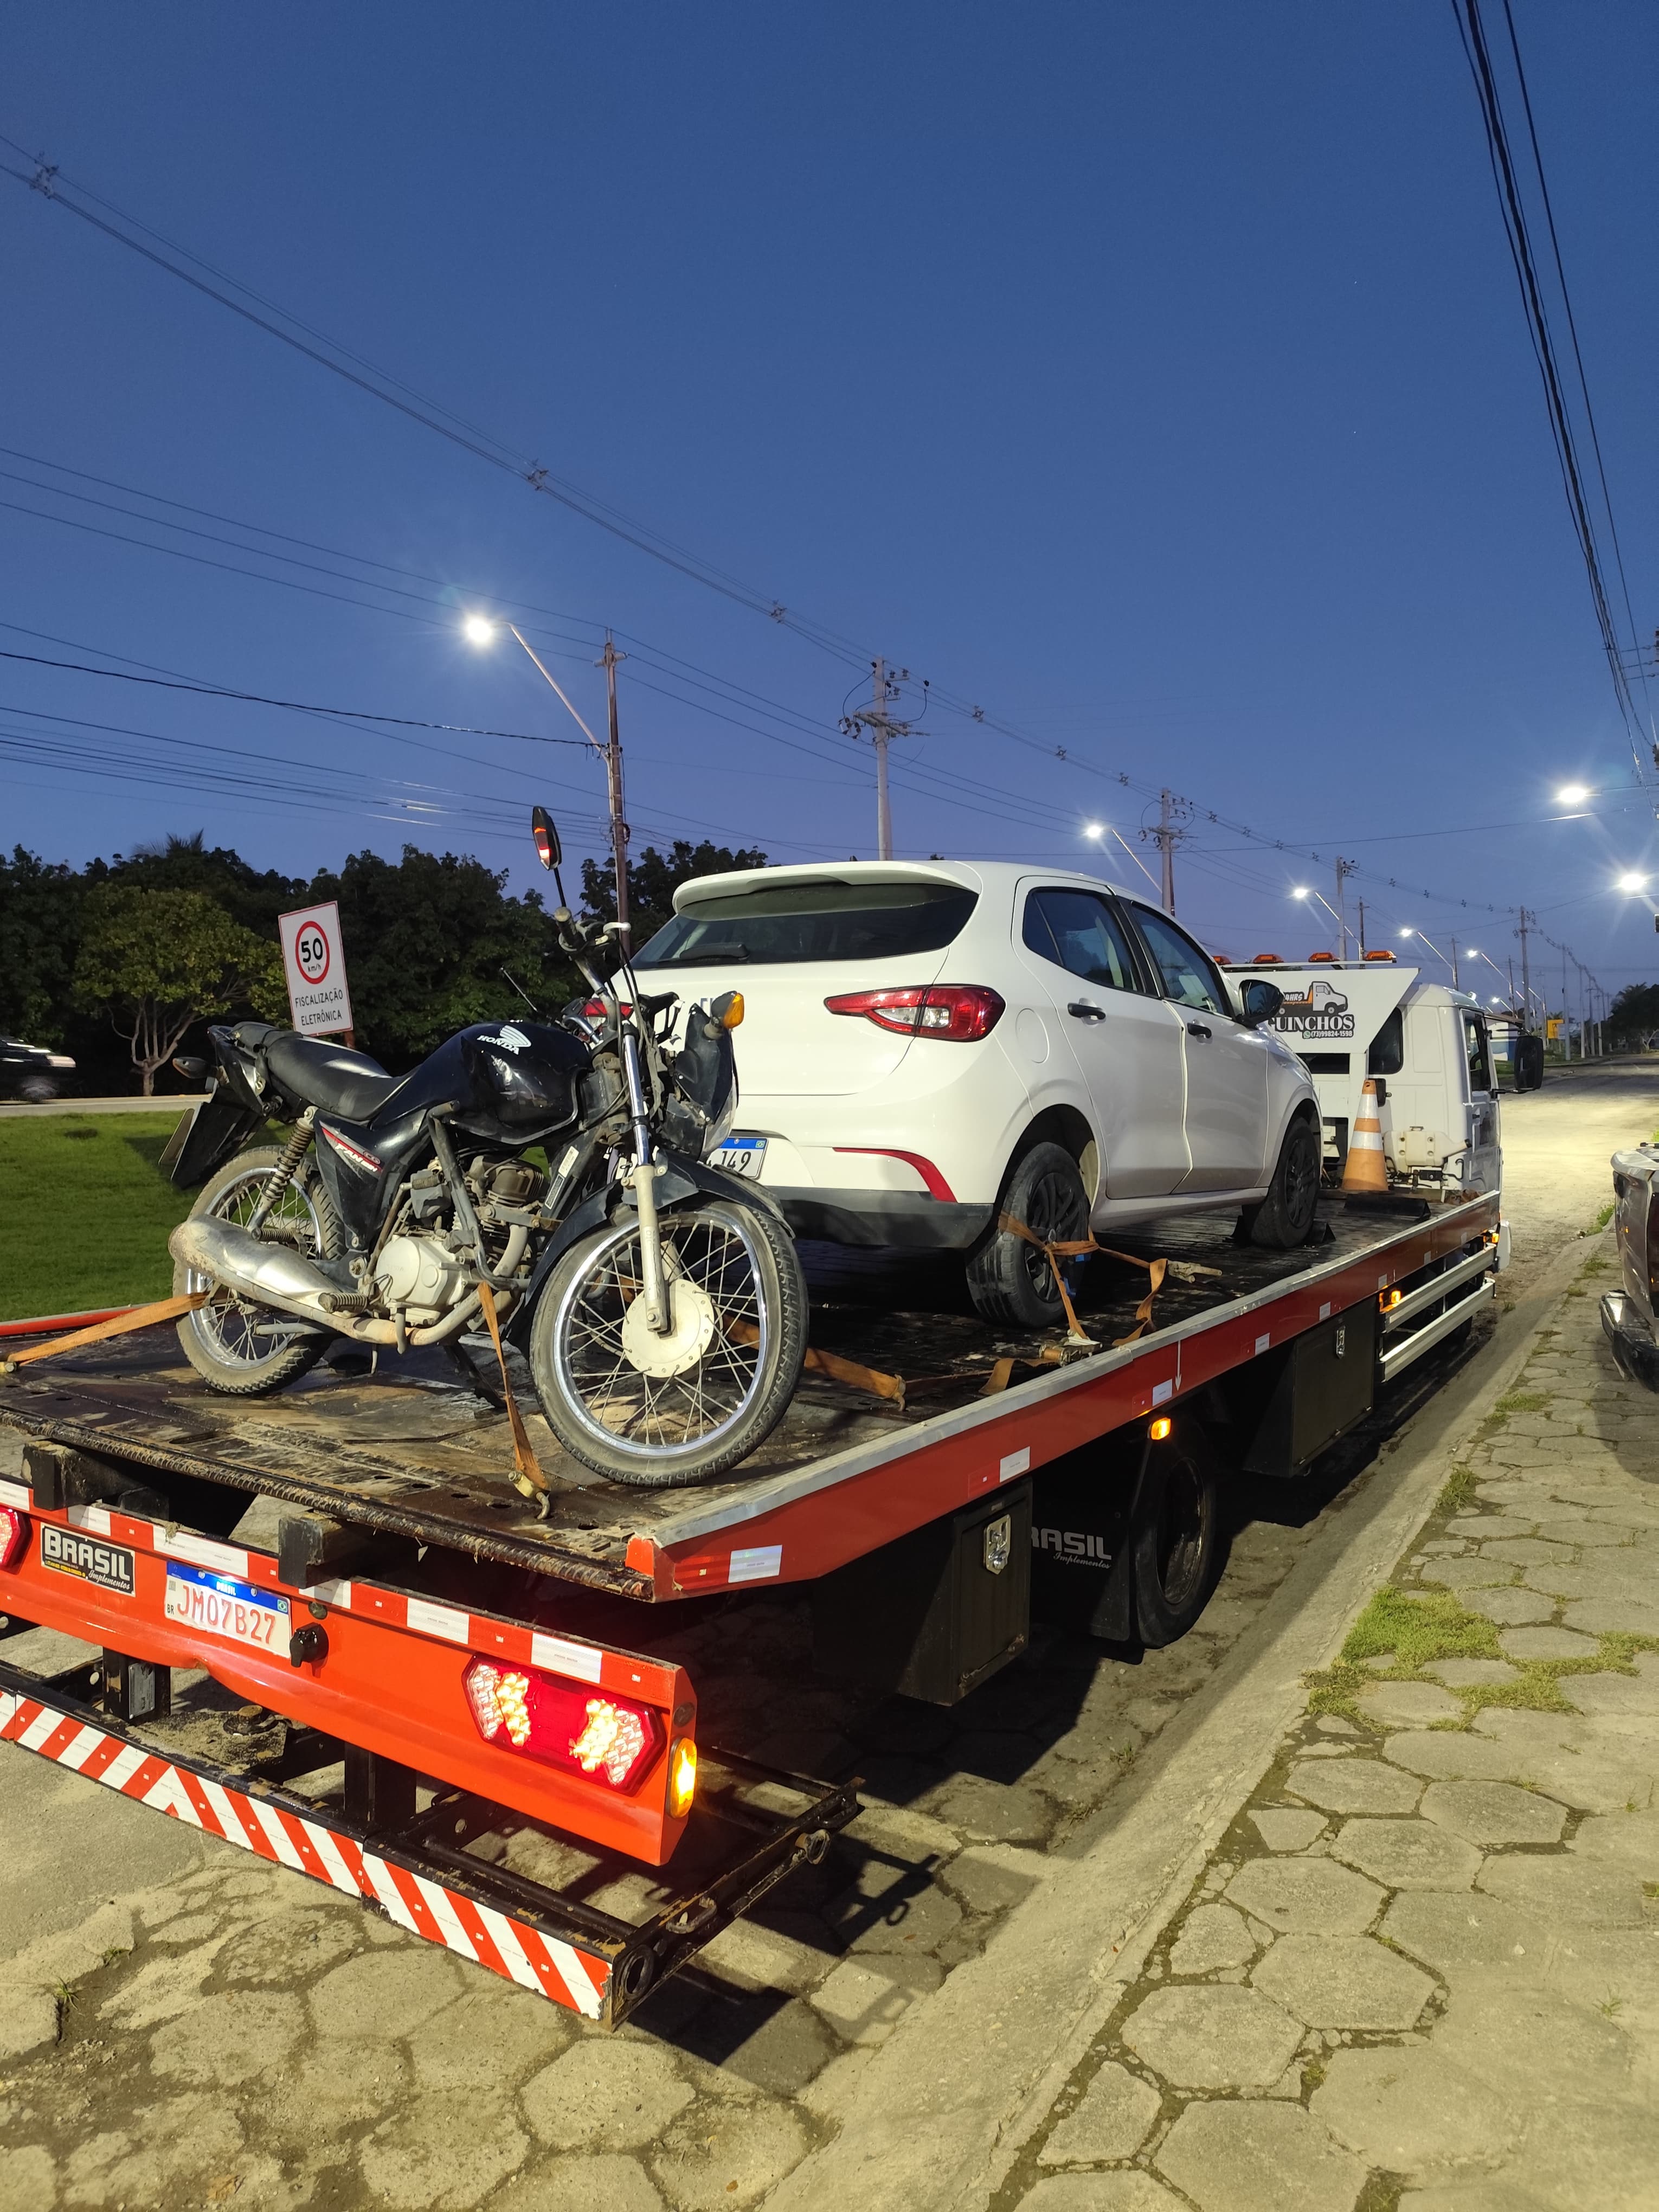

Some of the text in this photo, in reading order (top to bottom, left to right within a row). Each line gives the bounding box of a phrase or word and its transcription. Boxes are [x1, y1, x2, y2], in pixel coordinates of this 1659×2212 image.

[301, 937, 323, 963] 50
[307, 964, 321, 972] km/h
[295, 988, 343, 1008] FISCALIZAÇÃO
[1283, 993, 1303, 1001] 4HRS
[301, 1009, 342, 1026] ELETRÔNICA
[477, 1035, 519, 1055] HONDA
[335, 1142, 363, 1162] FAN
[44, 1528, 130, 1581] BRASIL
[1053, 1552, 1111, 1569] Implementos
[88, 1570, 130, 1590] Implementos
[216, 1581, 236, 1596] BRASIL
[167, 1604, 174, 1615] BR
